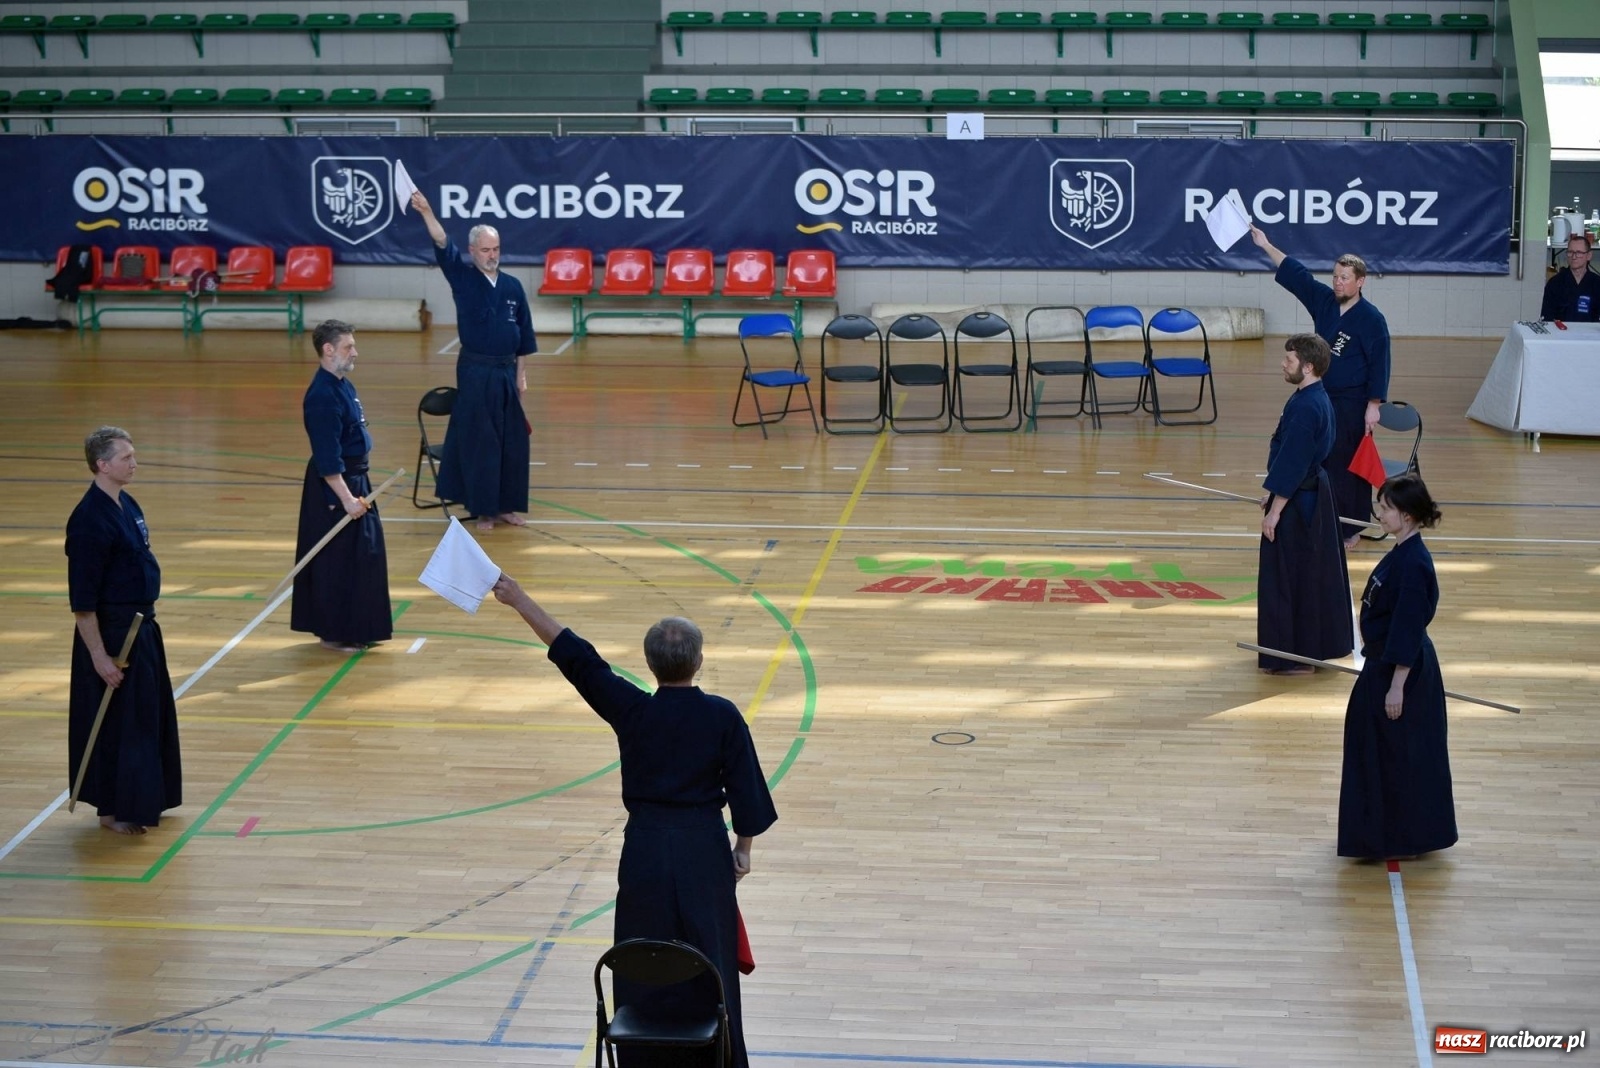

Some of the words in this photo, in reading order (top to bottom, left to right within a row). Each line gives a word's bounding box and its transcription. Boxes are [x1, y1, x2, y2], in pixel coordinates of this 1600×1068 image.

[959, 120, 972, 134] A
[72, 166, 209, 214] OSiR
[440, 171, 685, 219] RACIBÓRZ
[794, 168, 938, 217] OSiR
[127, 215, 209, 232] RACIBÓRZ
[851, 218, 938, 235] RACIBÓRZ
[856, 576, 1226, 604] RAFAKO
